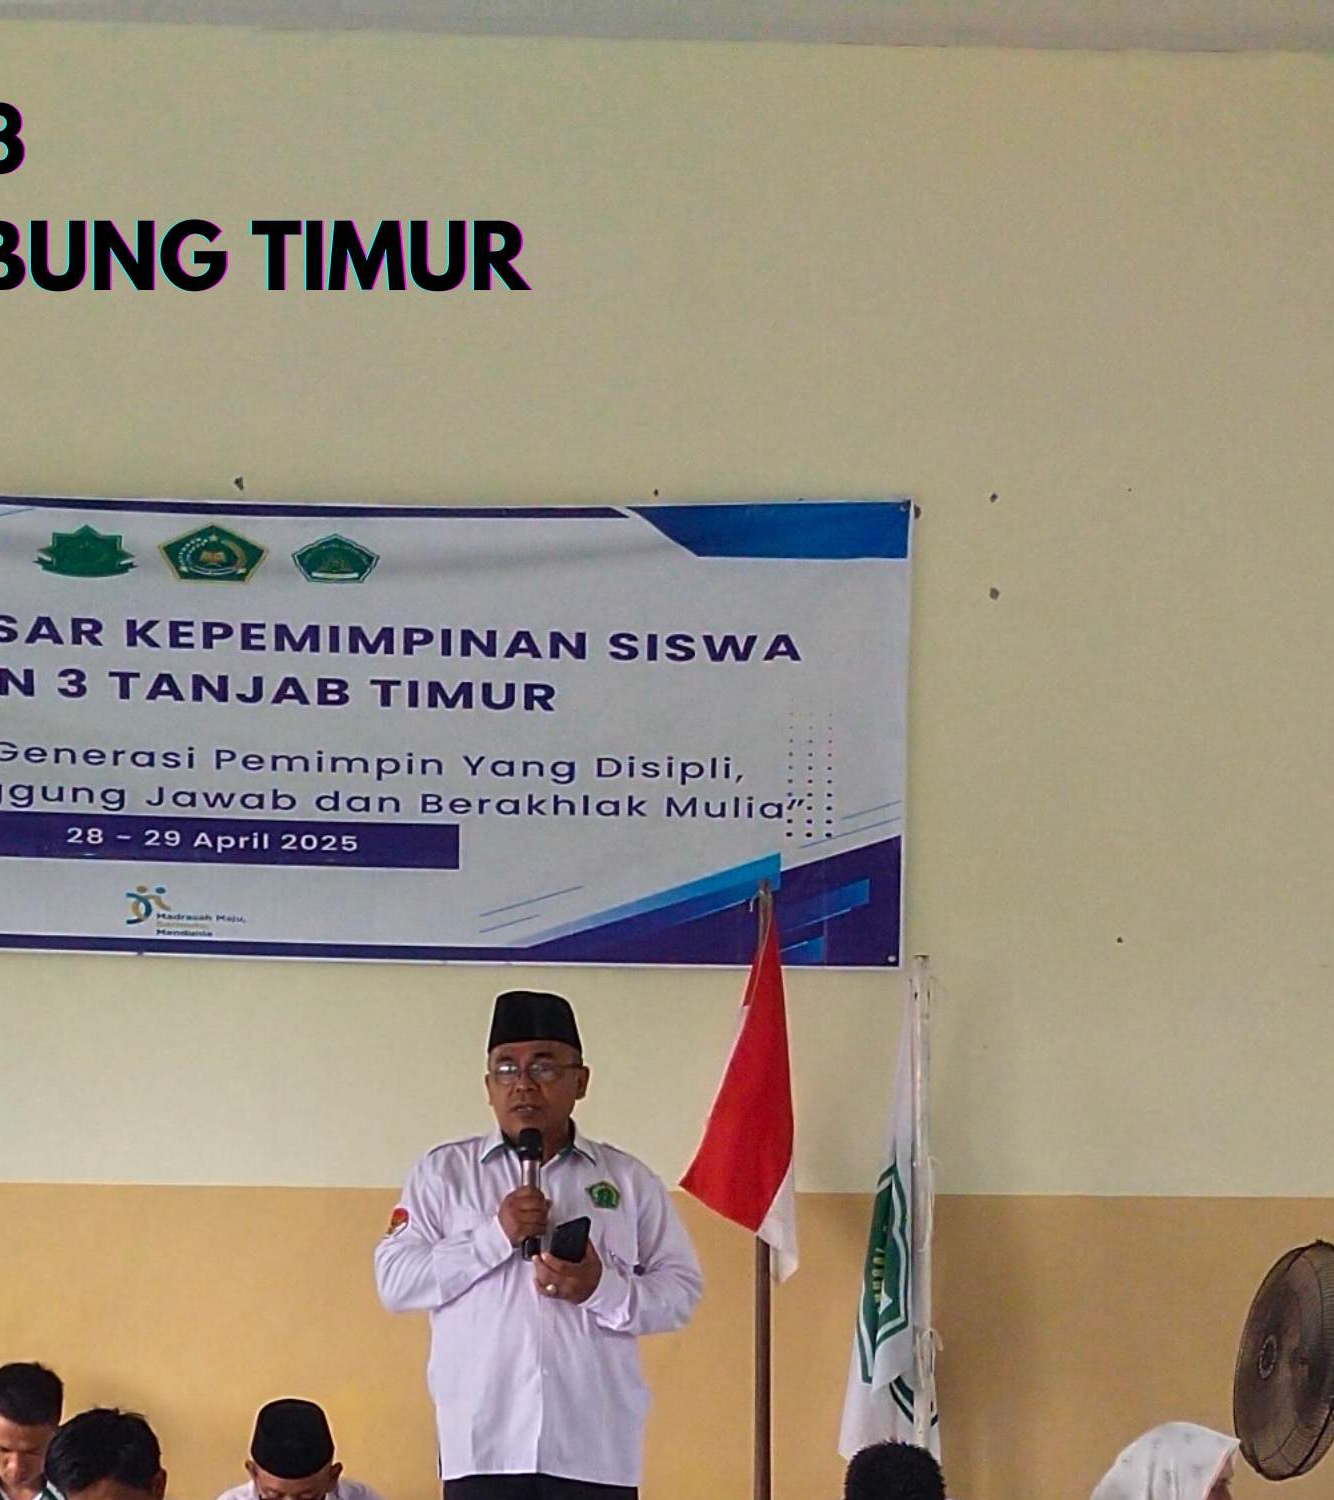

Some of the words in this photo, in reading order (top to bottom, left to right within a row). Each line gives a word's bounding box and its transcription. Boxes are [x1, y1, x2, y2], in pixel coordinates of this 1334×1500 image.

[125, 618, 588, 660] KEPEMIMPINAN
[608, 632, 802, 662] SISWA
[57, 667, 88, 699] 3
[108, 671, 351, 706] TANJAB
[370, 679, 557, 712] TIMUR
[215, 748, 444, 782] Pemimpin
[463, 755, 577, 783] Yang
[597, 756, 745, 786] Disipli,
[146, 786, 298, 811] Jawab
[315, 790, 401, 813] dan
[420, 792, 648, 817] Berakhlak
[67, 828, 104, 845] 28
[143, 830, 182, 848] 29
[193, 831, 269, 853] April
[280, 834, 359, 853] 2025
